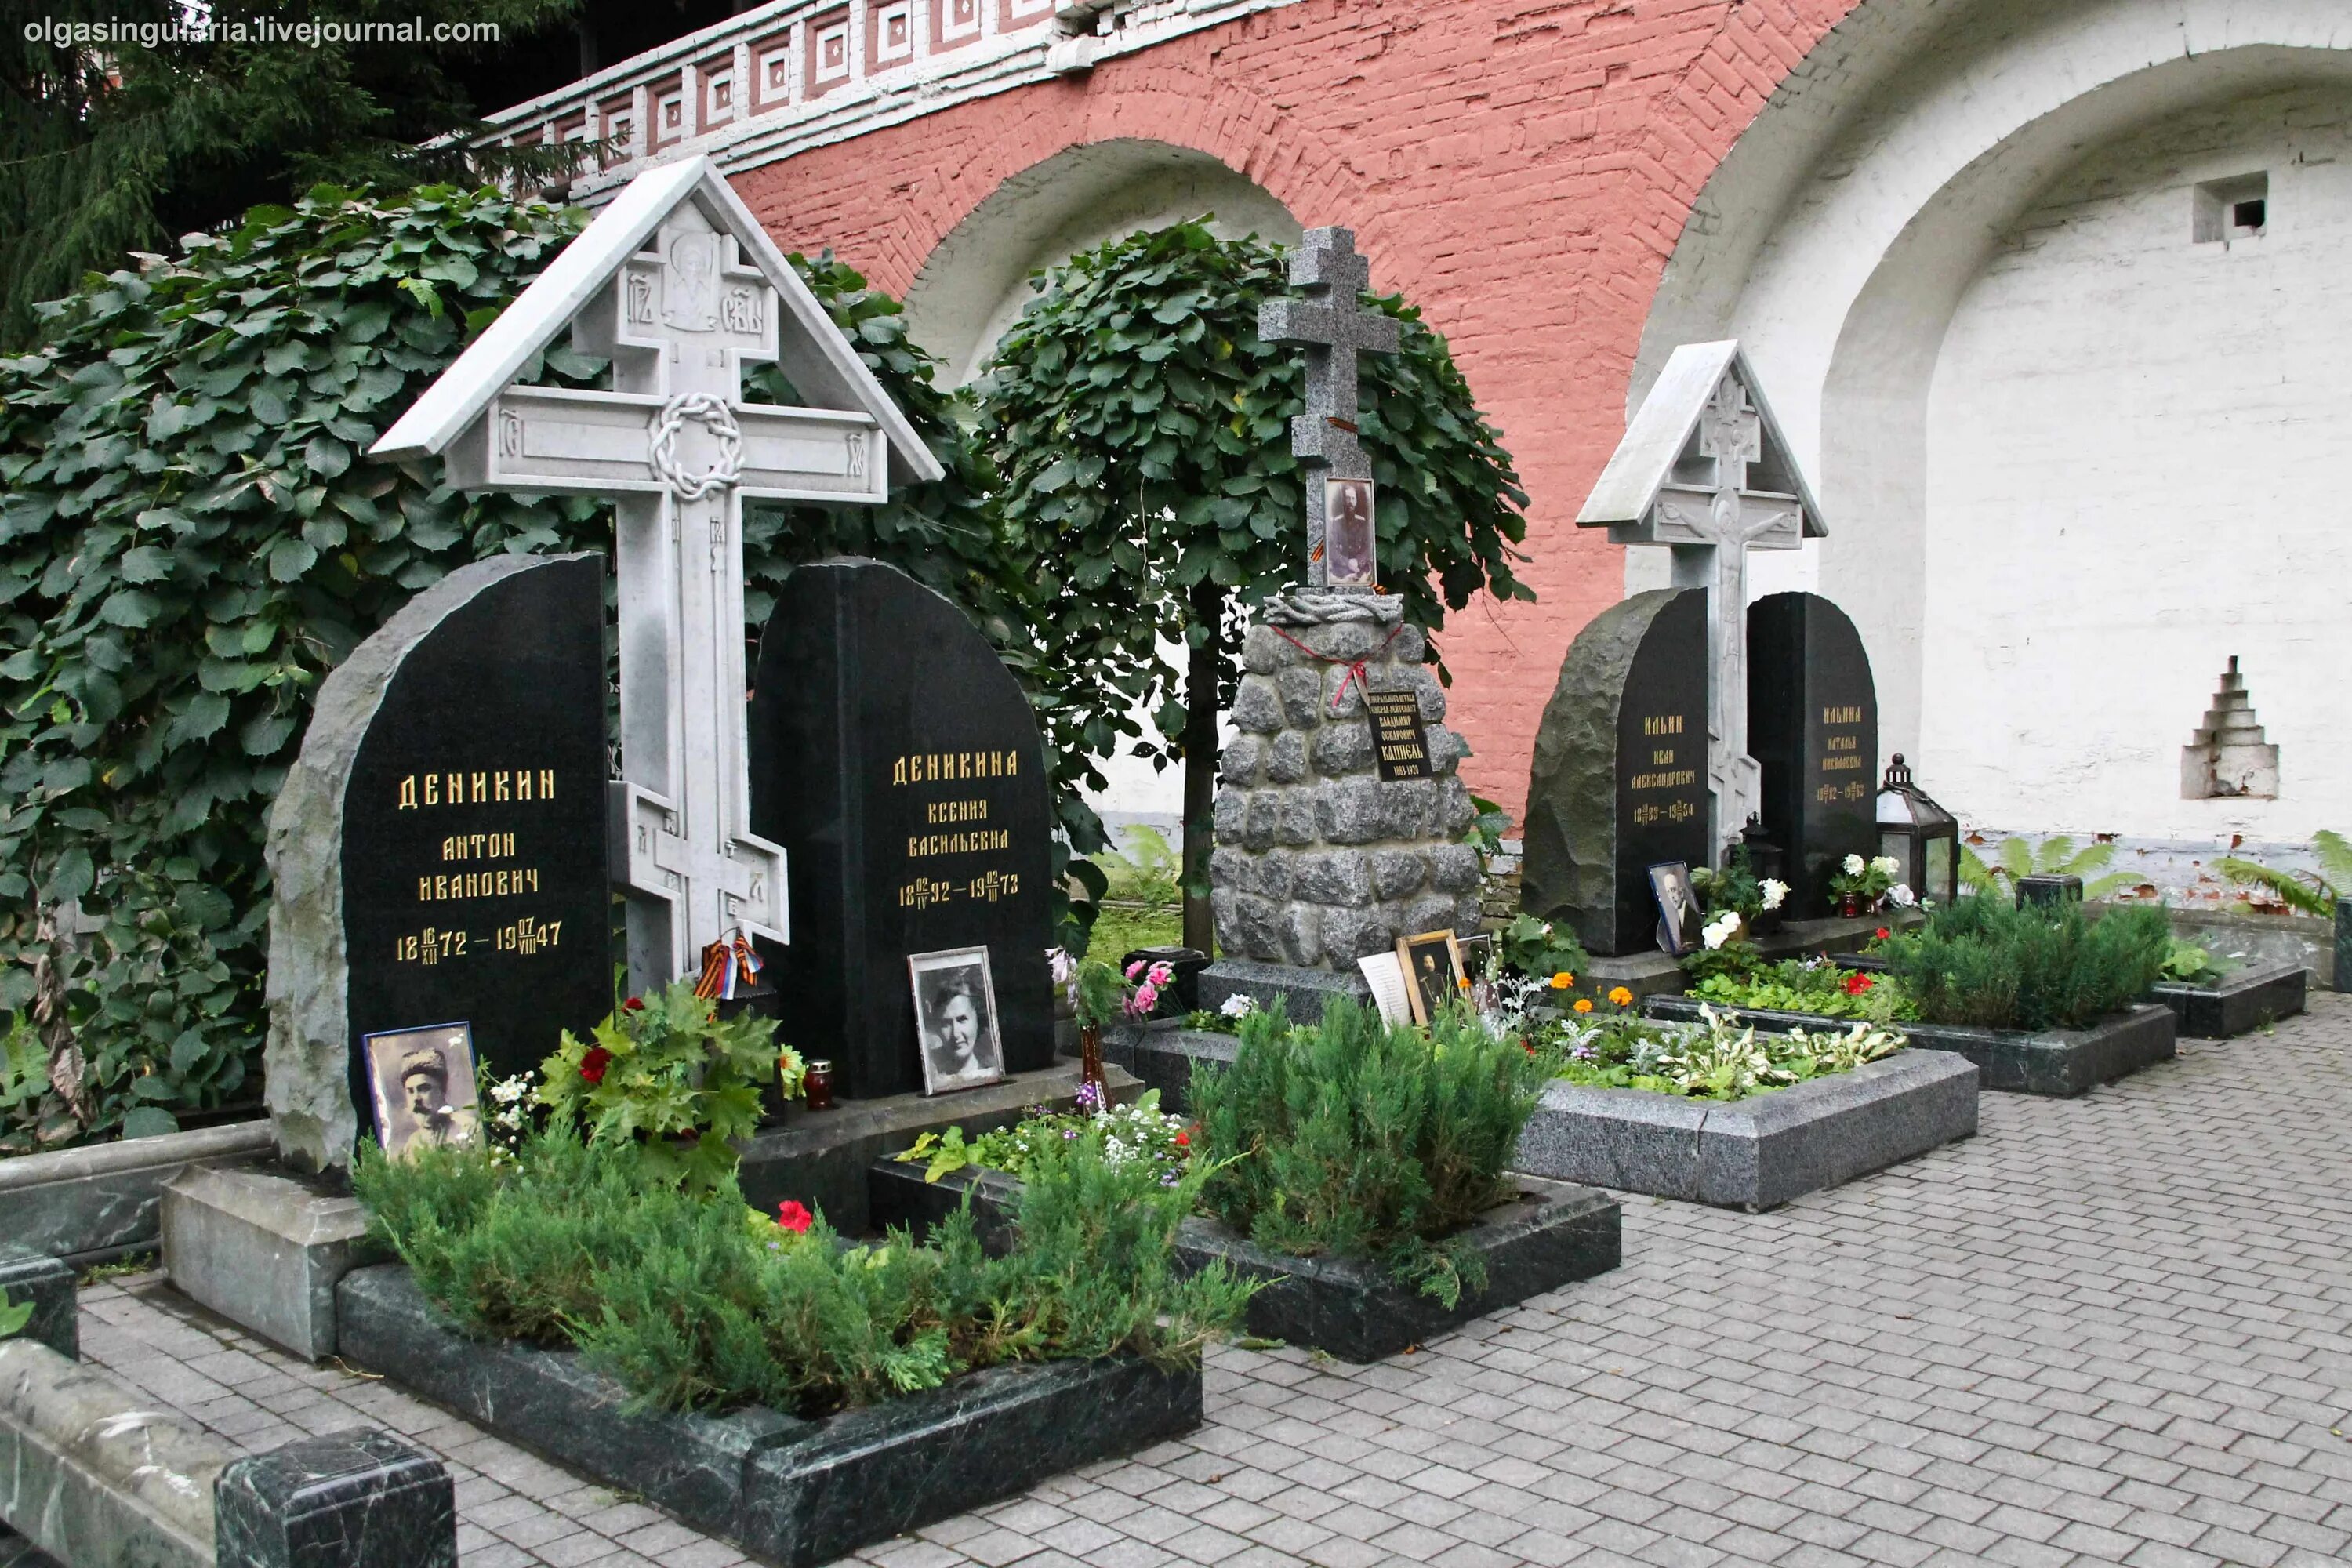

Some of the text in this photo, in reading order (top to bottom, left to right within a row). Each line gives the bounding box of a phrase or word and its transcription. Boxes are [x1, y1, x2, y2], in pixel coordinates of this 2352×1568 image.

[1379, 715, 1411, 728] ВЛАДИМИР
[1644, 714, 1682, 735] ИЛЬИН
[1824, 706, 1861, 724] ИЛЬИНА
[1381, 729, 1416, 741] ОСКАРОВИЧ
[1381, 743, 1424, 761] КАППЕЛЬ
[1653, 750, 1674, 765] ИВАН
[893, 750, 1018, 786] ДЕНИКИНА
[398, 769, 555, 811] ДЕНИКИН
[1631, 769, 1695, 790] АЛЕКСАНДРОВИЧ
[927, 799, 987, 824] КСЕНИЯ
[442, 833, 515, 861] АНТОН
[909, 829, 1009, 857] ВАСИЛЬЕВНА
[419, 868, 539, 902] ИВАНОВИЧ
